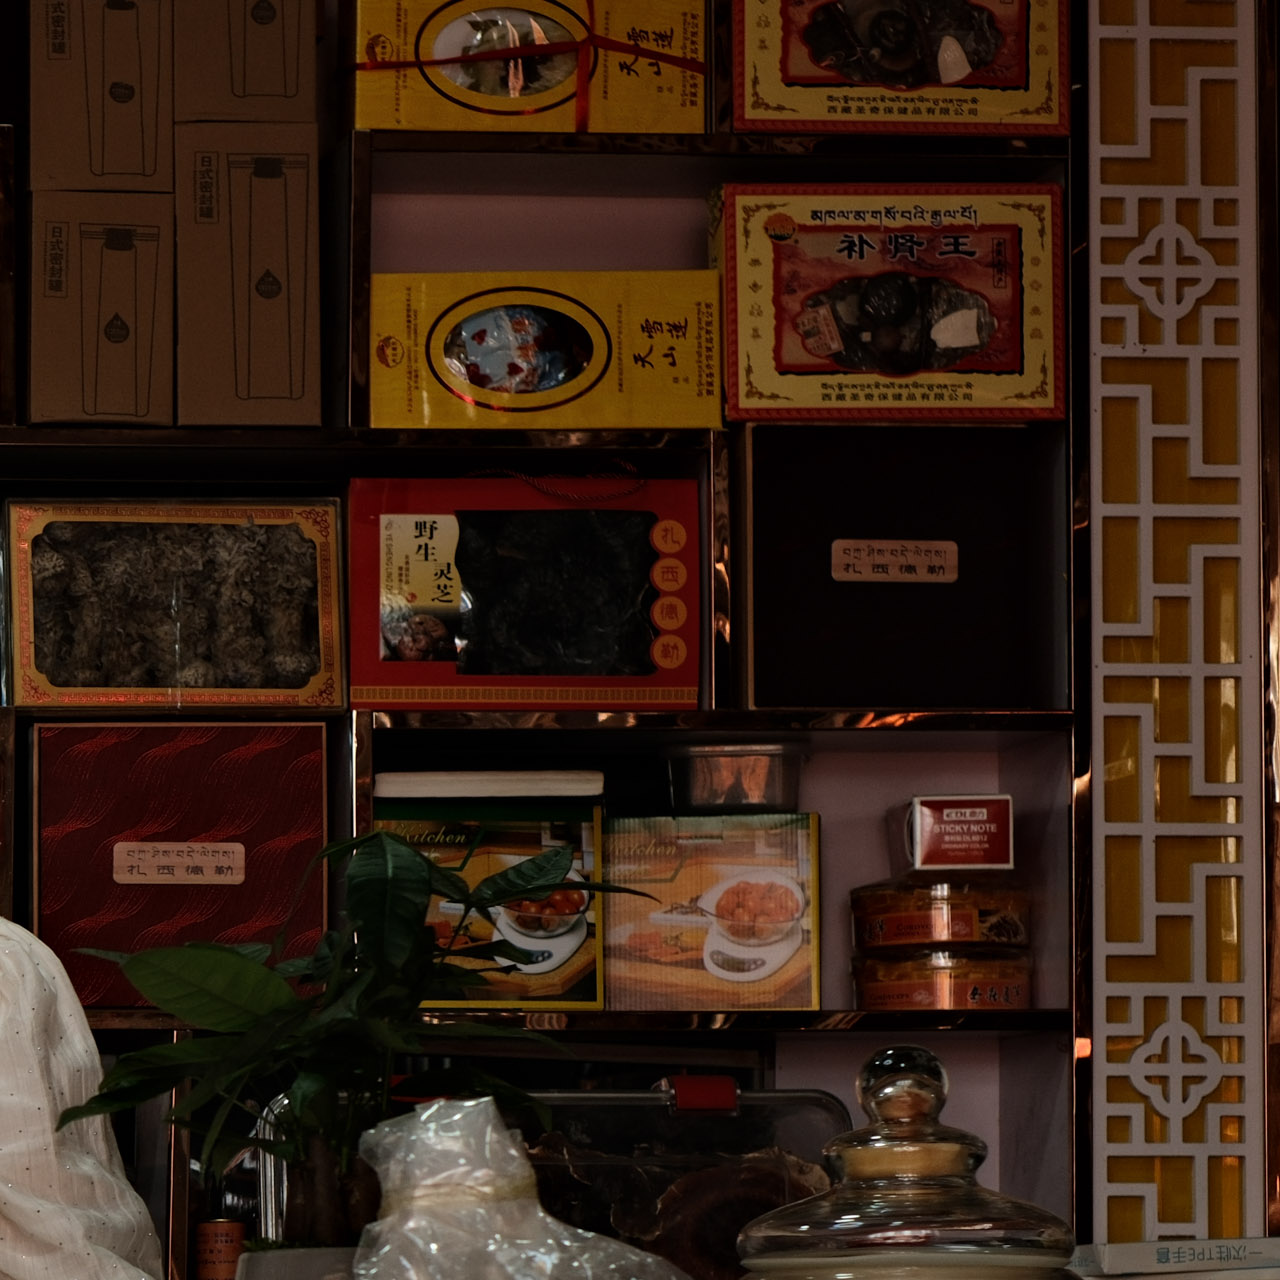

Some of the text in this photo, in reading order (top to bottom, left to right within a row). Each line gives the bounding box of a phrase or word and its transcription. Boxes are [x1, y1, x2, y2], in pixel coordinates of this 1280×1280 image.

[837, 233, 977, 260] 补肾王
[414, 520, 454, 604] 野生灵芝
[843, 563, 946, 576] 扎西德勒
[659, 522, 680, 664] 扎西德勒
[933, 823, 998, 833] STICKY NOTE
[127, 864, 235, 878] 扎西德勒
[1156, 1245, 1263, 1265] 一次性TPE手套
